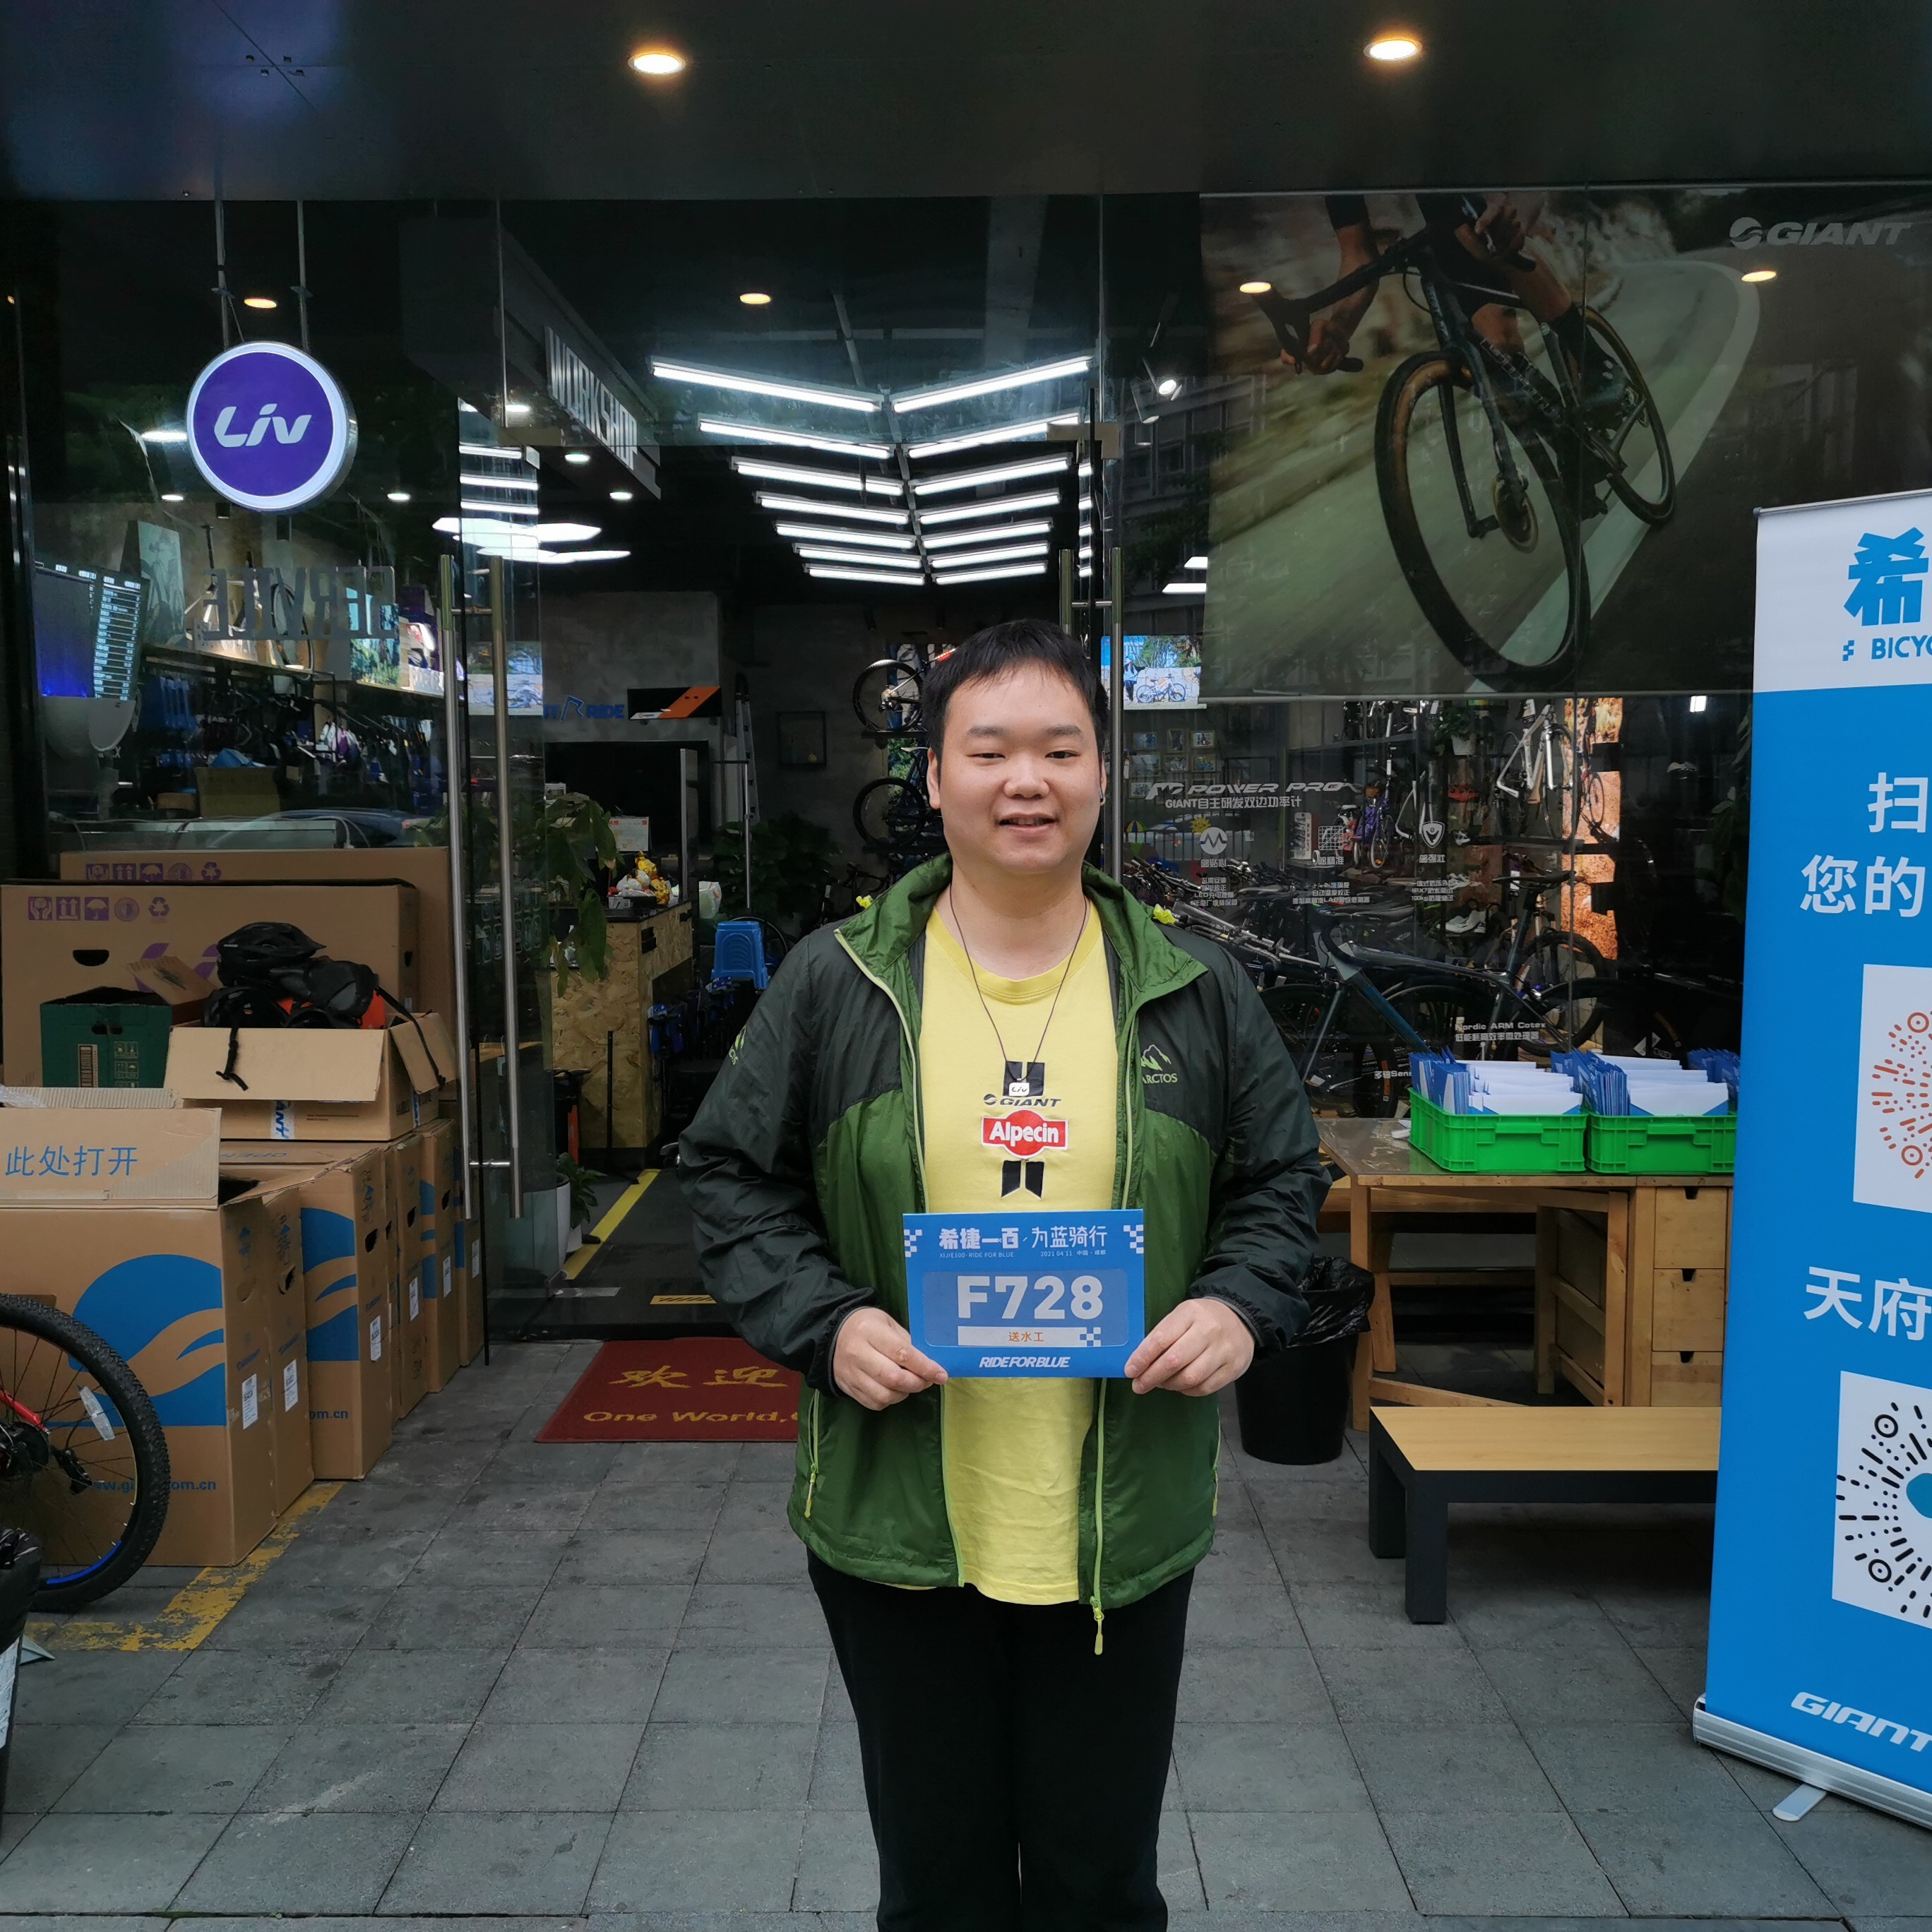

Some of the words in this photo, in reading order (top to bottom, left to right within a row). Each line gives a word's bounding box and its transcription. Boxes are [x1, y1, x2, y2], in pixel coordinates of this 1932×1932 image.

[1767, 222, 1913, 246] GIANT
[549, 327, 638, 471] WORKSHOP
[214, 403, 312, 447] Liv
[1844, 527, 1929, 626] 希
[1187, 783, 1280, 794] POWER
[1286, 782, 1344, 792] PRO
[1868, 773, 1928, 833] 扫
[1800, 854, 1926, 917] 您的
[1455, 1022, 1487, 1031] Nordic
[1000, 1098, 1062, 1107] GIANT
[989, 1121, 1059, 1147] Alpecin
[5, 1145, 138, 1176] 此处打开
[938, 1227, 1019, 1249] 希捷一百
[1031, 1225, 1108, 1248] 为蓝骑行
[958, 1275, 1104, 1320] F728
[1803, 1266, 1932, 1340] 天府
[1008, 1331, 1044, 1342] 送水工
[609, 1365, 788, 1388] 欢迎
[583, 1412, 657, 1422] One
[1791, 1691, 1932, 1752] GIANT
